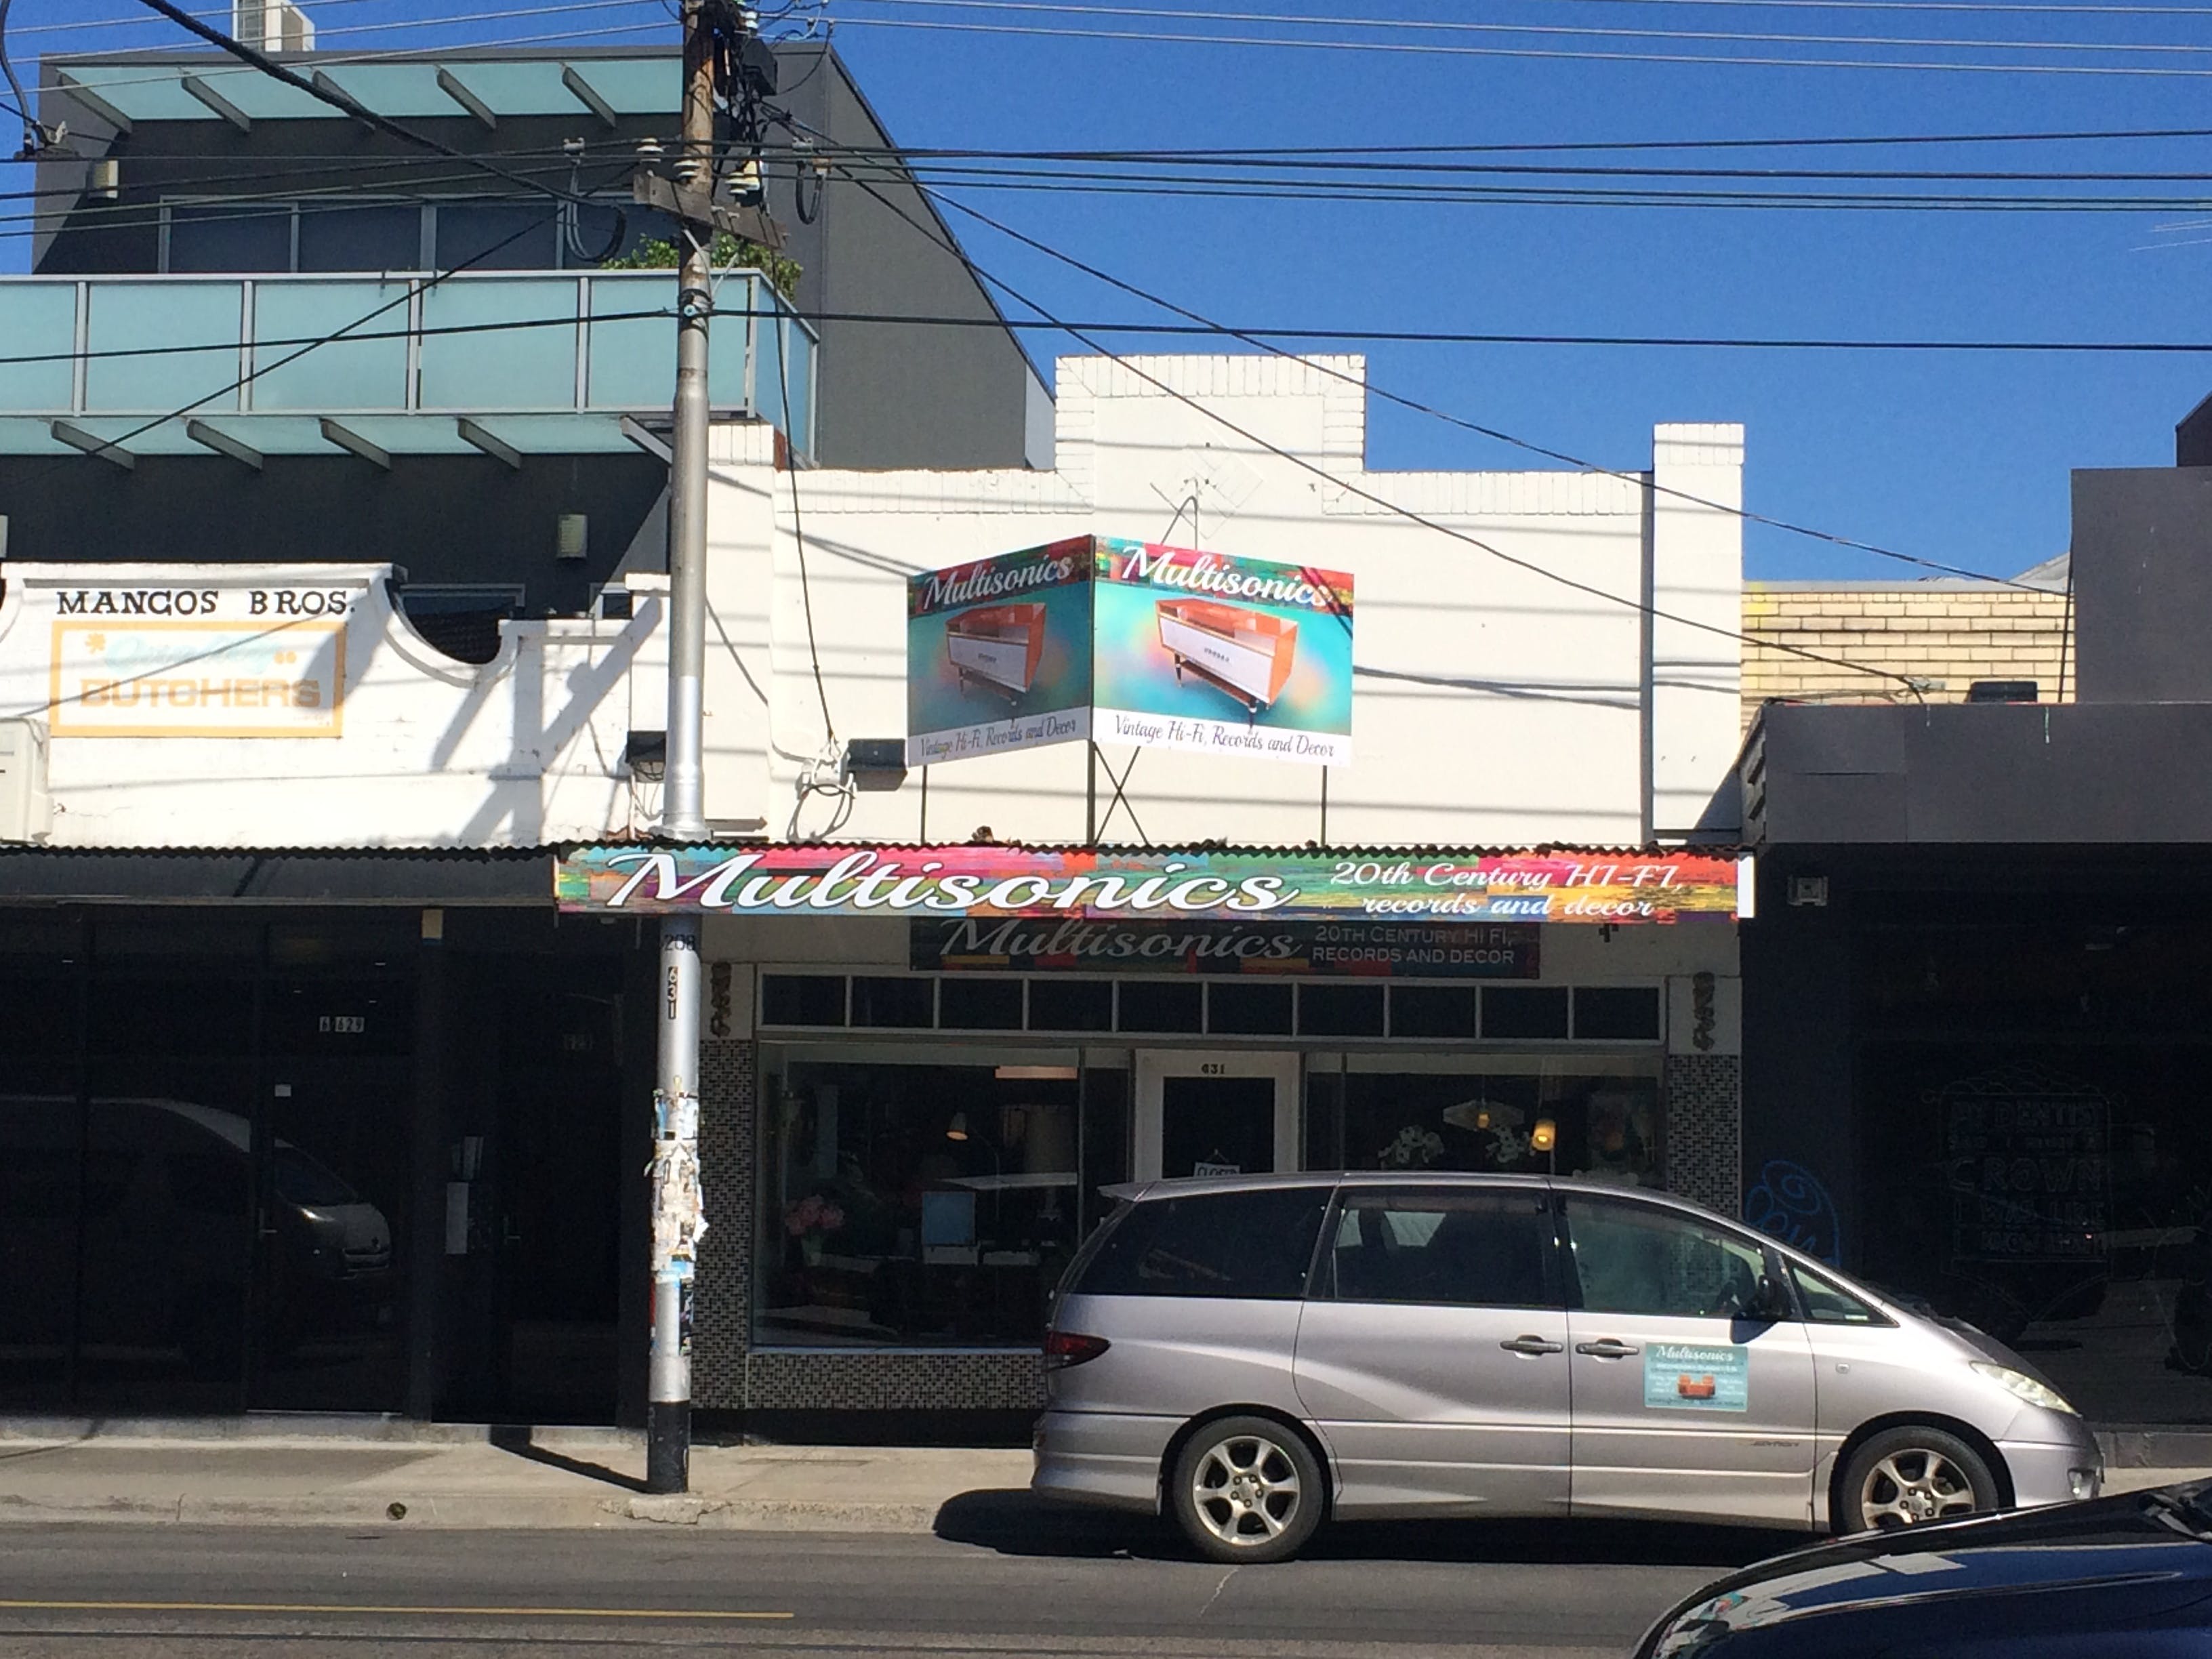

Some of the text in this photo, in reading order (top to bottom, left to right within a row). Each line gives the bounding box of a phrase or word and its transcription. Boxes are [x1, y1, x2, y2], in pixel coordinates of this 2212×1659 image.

[923, 554, 1074, 610] Multisonics
[1122, 546, 1333, 607] Multisonics
[920, 738, 954, 759] Vintage
[986, 723, 1023, 747] Records
[1025, 720, 1044, 739] and
[1046, 716, 1076, 738] Decor
[1115, 714, 1164, 743] Vintage
[1212, 725, 1263, 750] Records
[1267, 735, 1294, 754] and
[1296, 734, 1334, 758] Decor
[606, 850, 1301, 912] Multisonics
[1330, 862, 1414, 887] 20th
[1424, 862, 1553, 891] Century
[1361, 893, 1655, 917] records and decor
[939, 919, 1303, 960] Multisonics
[1312, 947, 1515, 966] RECORDS AND DECOR
[1201, 1063, 1225, 1075] 631
[1656, 1345, 1734, 1361] Multisonics
